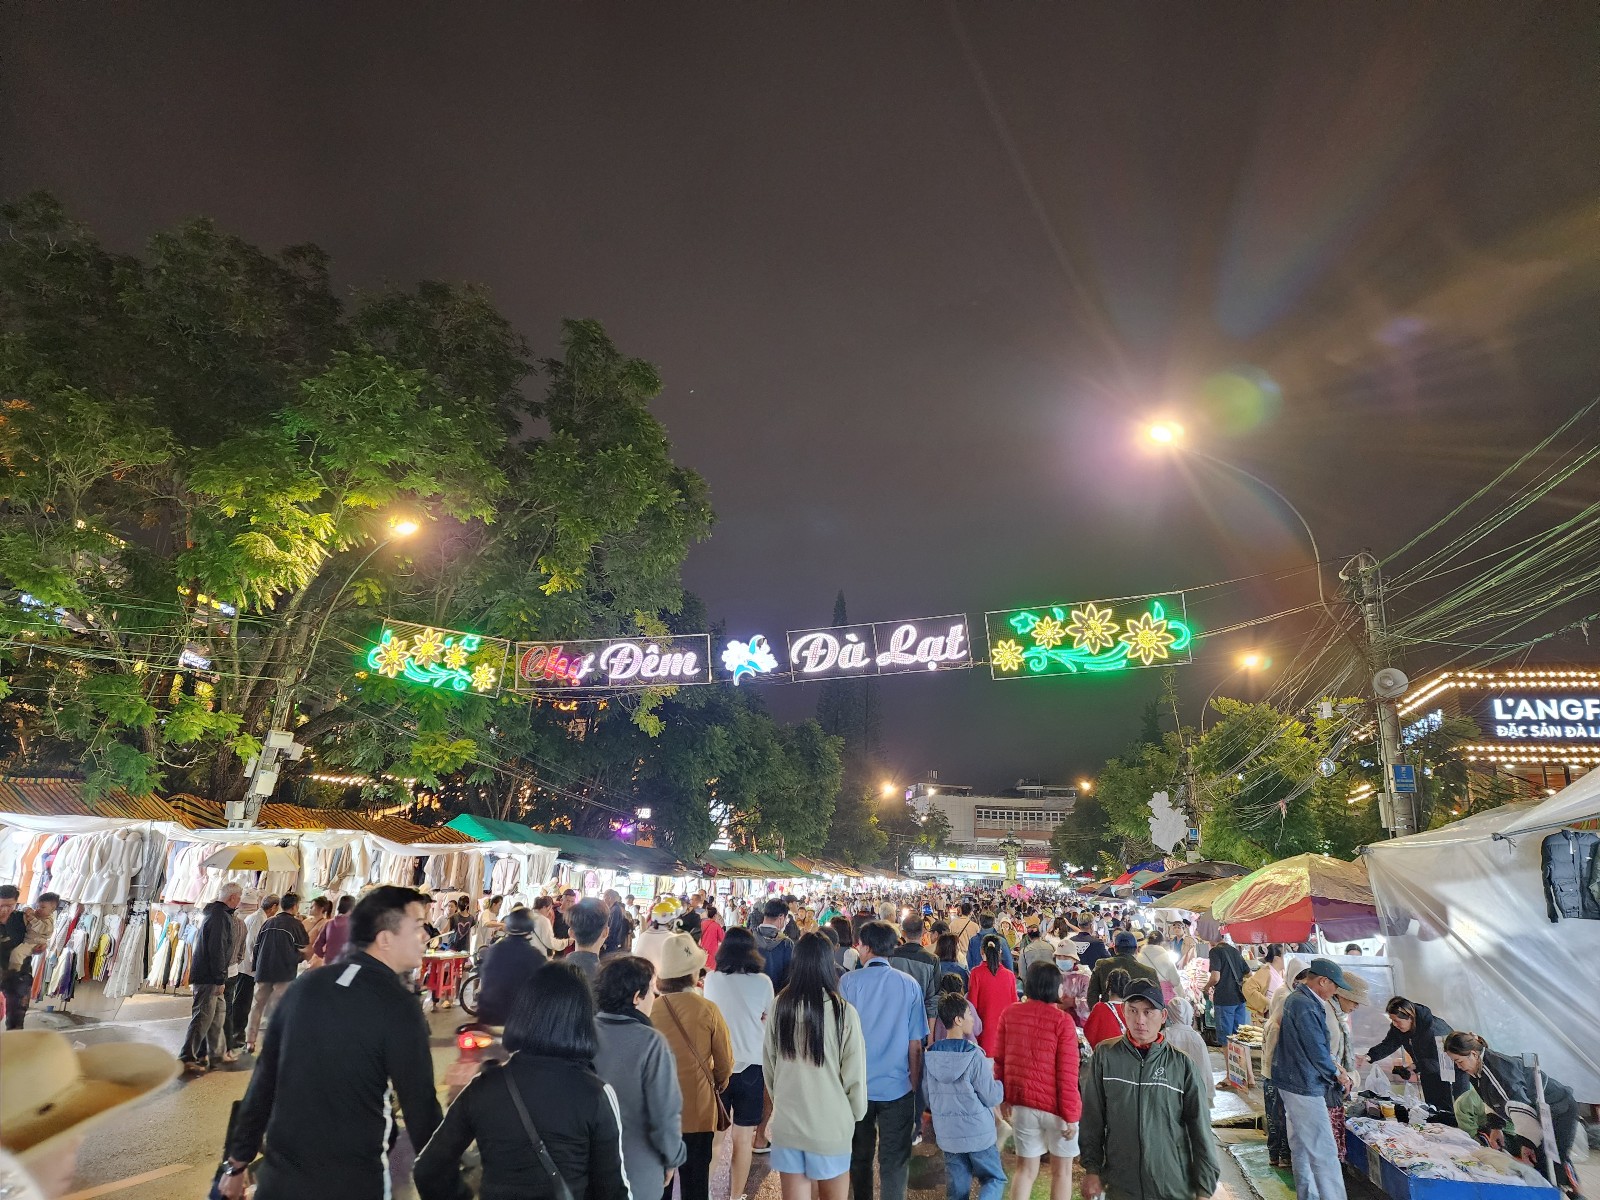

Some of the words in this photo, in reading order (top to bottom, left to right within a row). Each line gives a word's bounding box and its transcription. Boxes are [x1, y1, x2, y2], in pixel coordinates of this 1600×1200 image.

[520, 645, 596, 686] Chợ
[599, 643, 702, 679] Đêm
[790, 632, 871, 673] Đà
[875, 624, 968, 671] Lạt
[1496, 722, 1528, 739] ĐẶC
[1529, 722, 1563, 738] SẢN
[1564, 722, 1588, 738] ĐÀ
